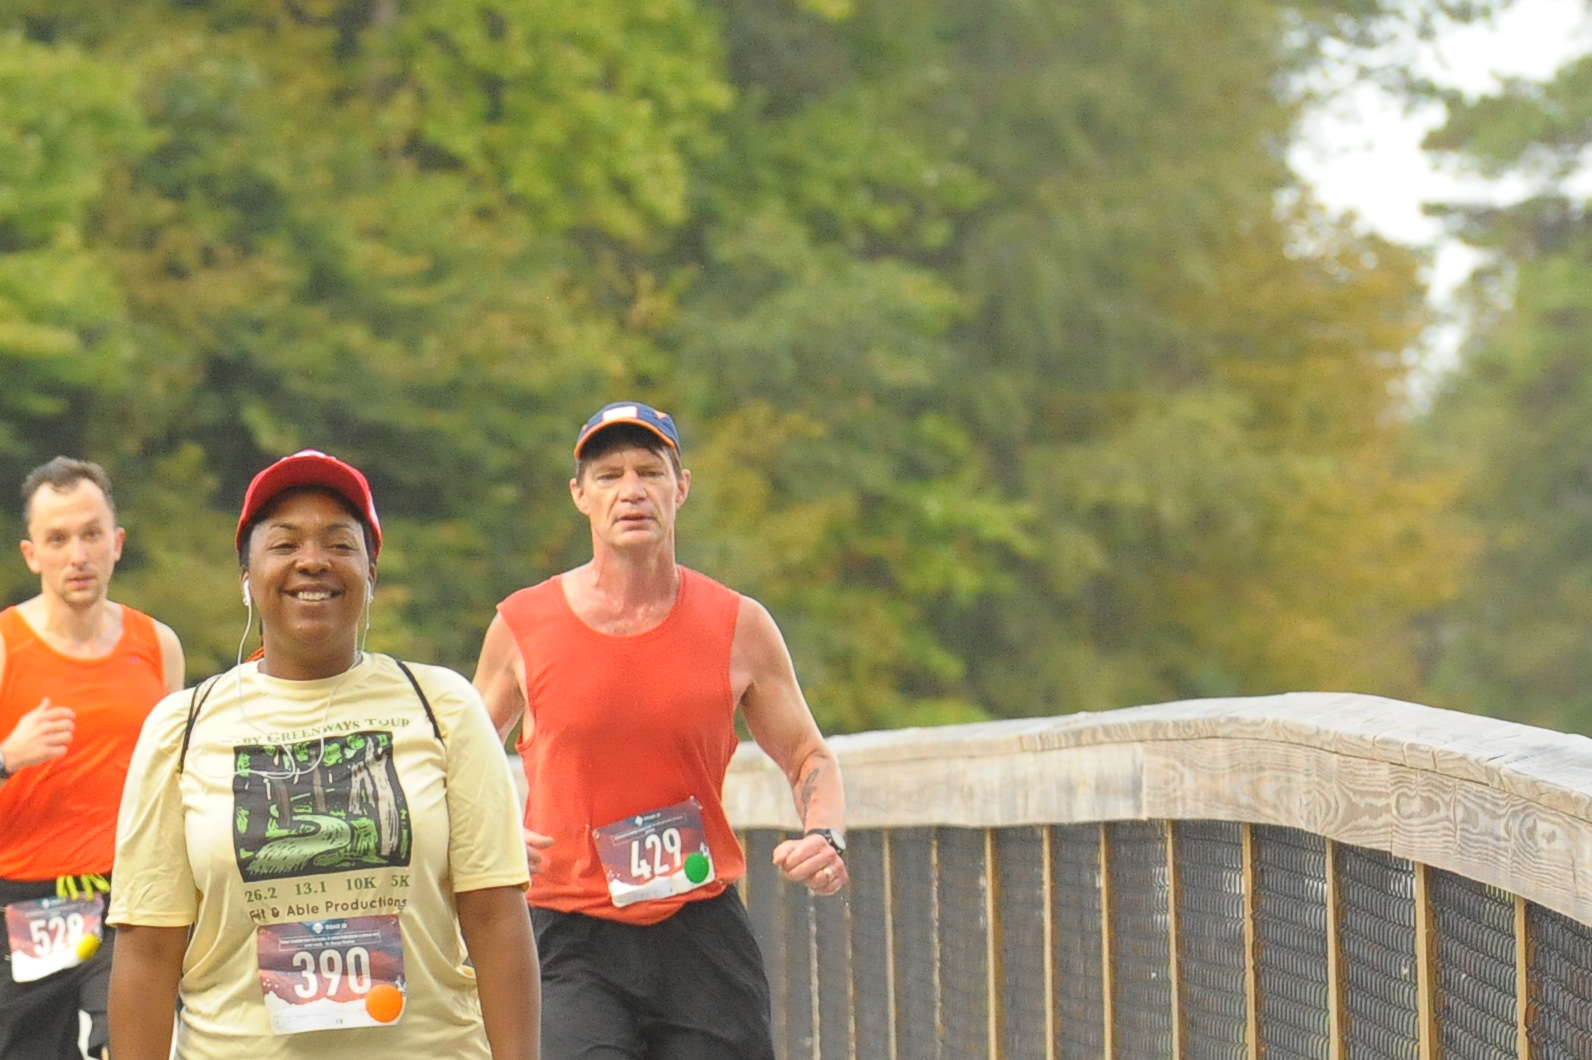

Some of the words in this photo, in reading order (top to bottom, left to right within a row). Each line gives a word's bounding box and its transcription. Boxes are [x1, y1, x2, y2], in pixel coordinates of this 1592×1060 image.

[630, 828, 682, 879] 429
[245, 887, 278, 903] 26.2
[295, 880, 327, 896] 13.1
[346, 876, 377, 891] 10K
[390, 874, 410, 888] 5K
[271, 906, 280, 918] &
[287, 902, 319, 917] Able
[325, 896, 408, 914] Productions
[292, 947, 372, 999] 390
